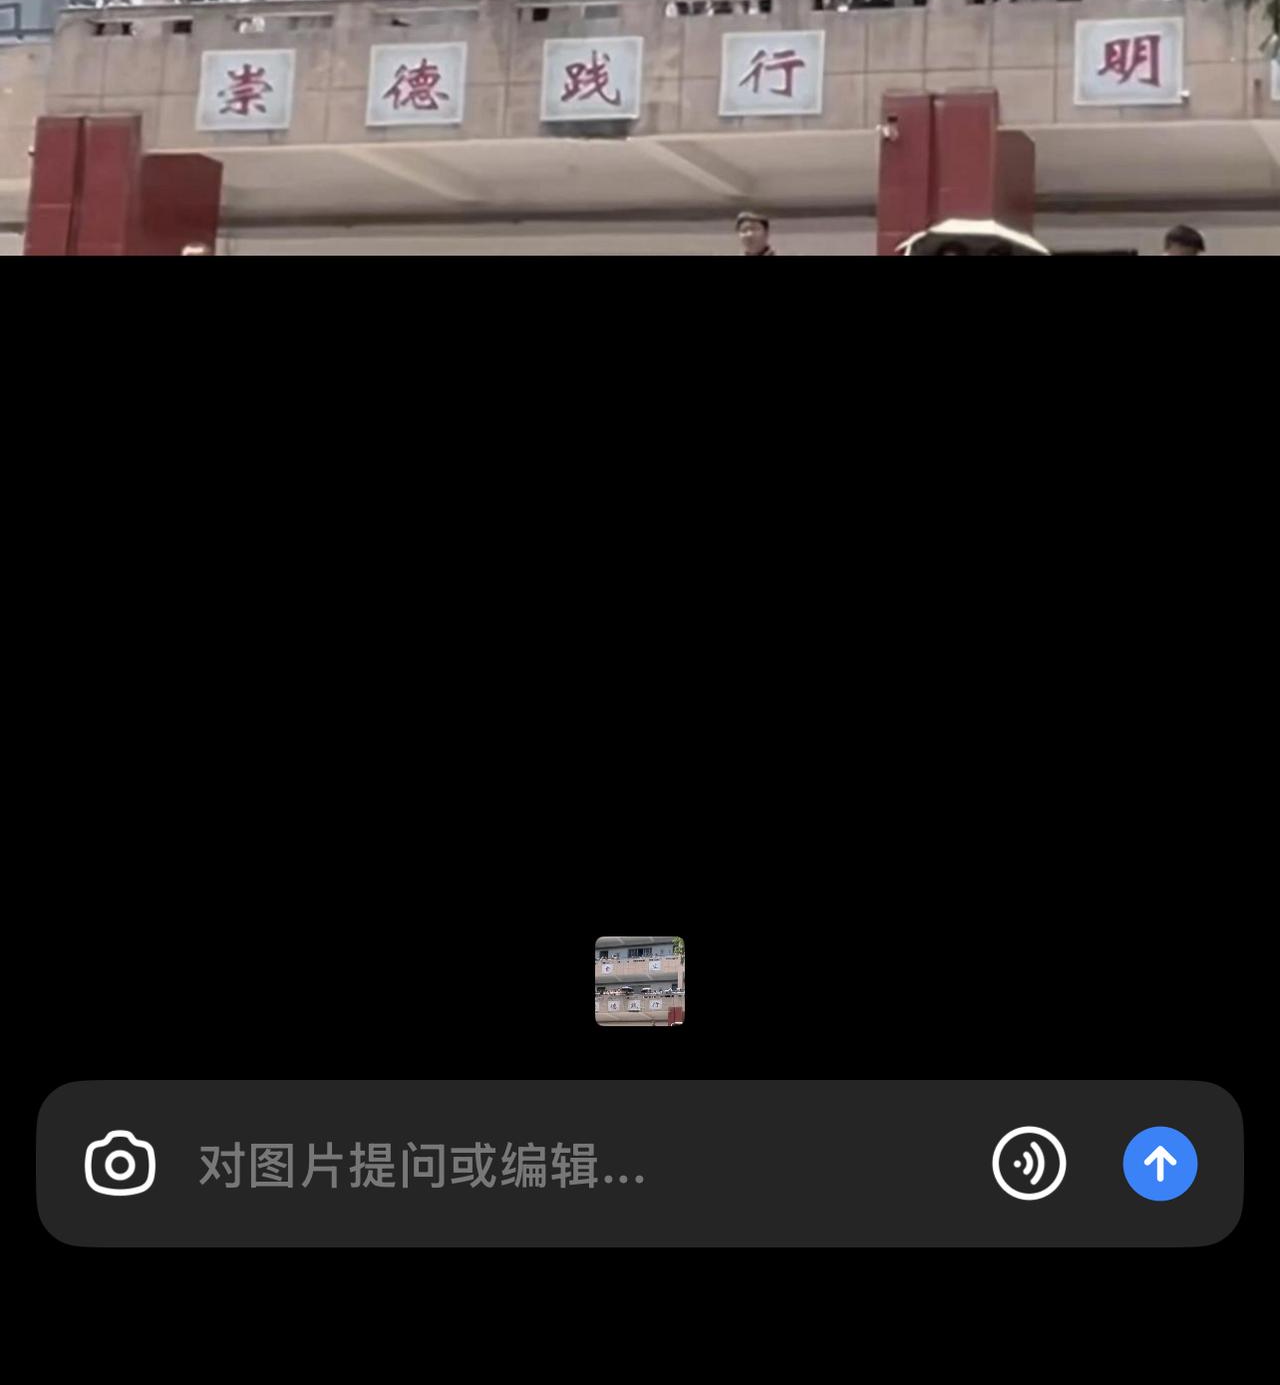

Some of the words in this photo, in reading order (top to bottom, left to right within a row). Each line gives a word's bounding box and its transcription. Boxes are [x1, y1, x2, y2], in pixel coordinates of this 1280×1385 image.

[217, 63, 274, 116] 崇
[383, 57, 450, 111] 德
[561, 49, 622, 107] 践
[739, 48, 806, 98] 行
[1098, 33, 1163, 87] 明
